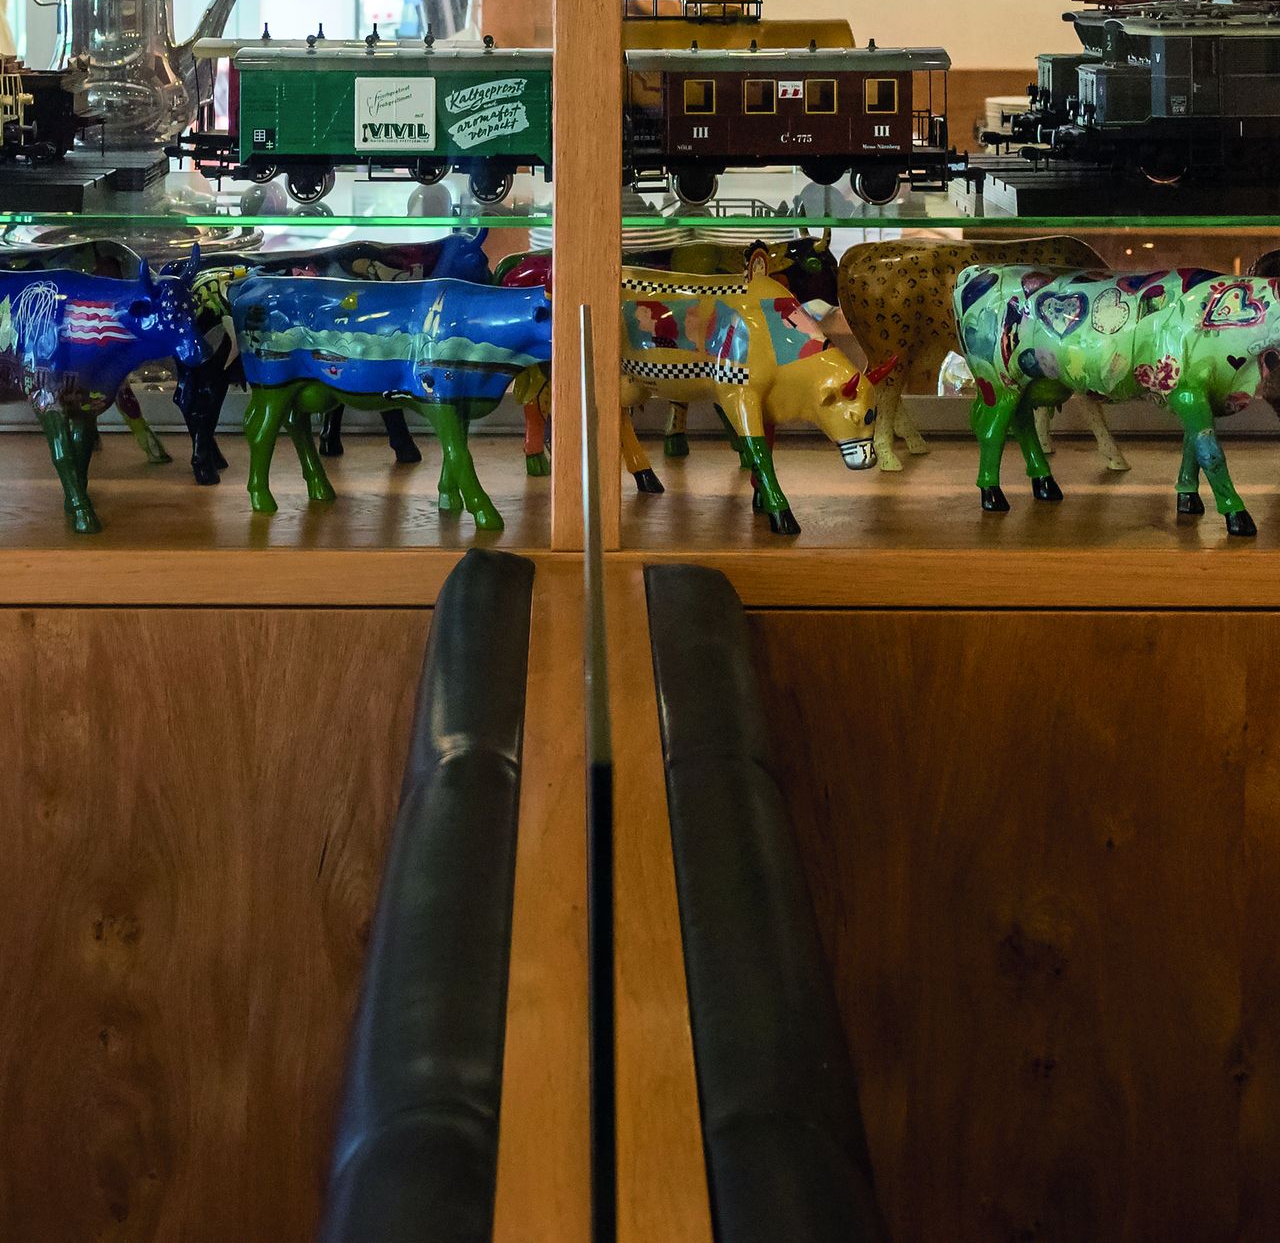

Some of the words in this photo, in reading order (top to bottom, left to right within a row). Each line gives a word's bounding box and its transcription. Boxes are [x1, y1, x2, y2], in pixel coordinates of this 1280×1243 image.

[457, 104, 522, 134] aromafest
[368, 122, 430, 140] VIVIL
[468, 118, 519, 141] verpackt
[692, 126, 709, 138] III
[874, 125, 890, 137] III
